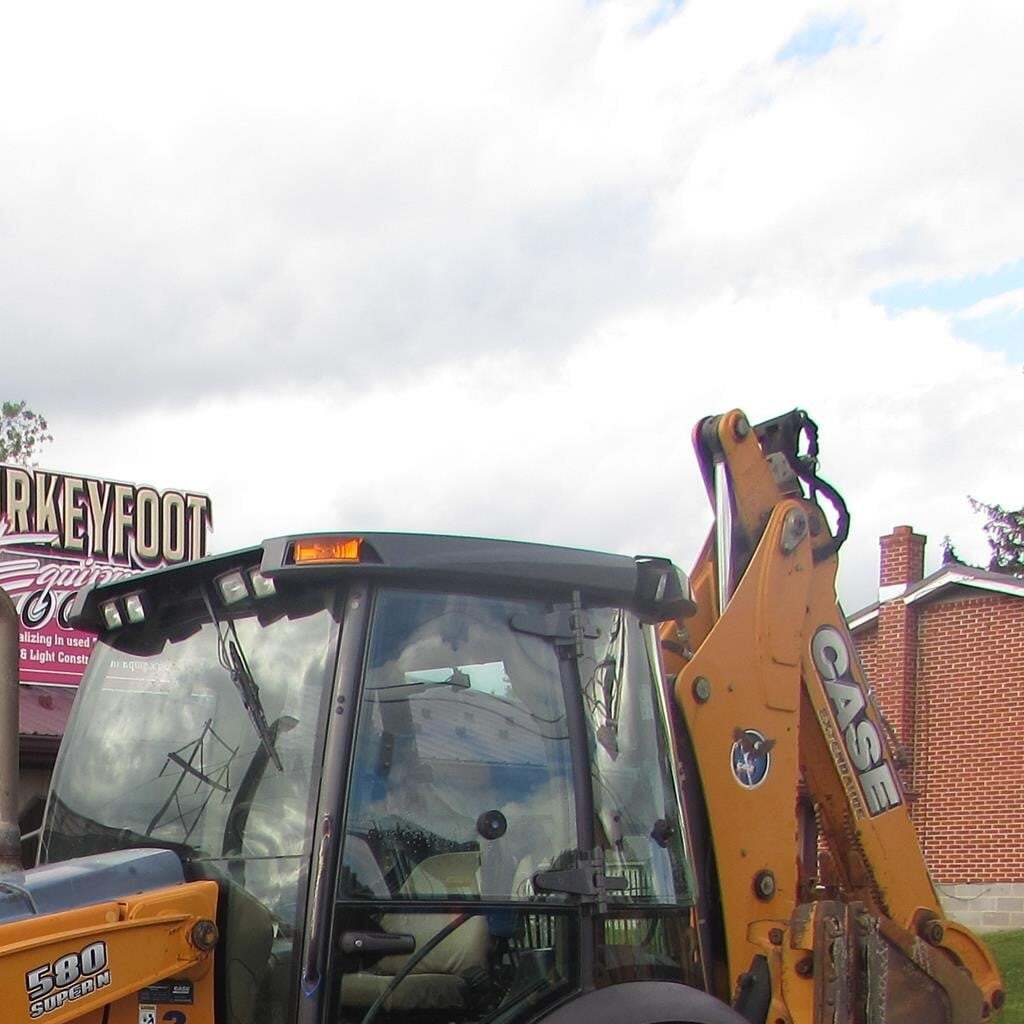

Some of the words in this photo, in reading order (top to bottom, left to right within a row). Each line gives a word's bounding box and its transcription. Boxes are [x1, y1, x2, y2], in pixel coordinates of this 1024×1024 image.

[20, 649, 27, 660] &
[30, 650, 55, 664] Light
[67, 636, 90, 648] used
[811, 627, 902, 815] CASE
[26, 942, 107, 1001] 580
[30, 978, 94, 1018] SUPER
[96, 969, 111, 989] N
